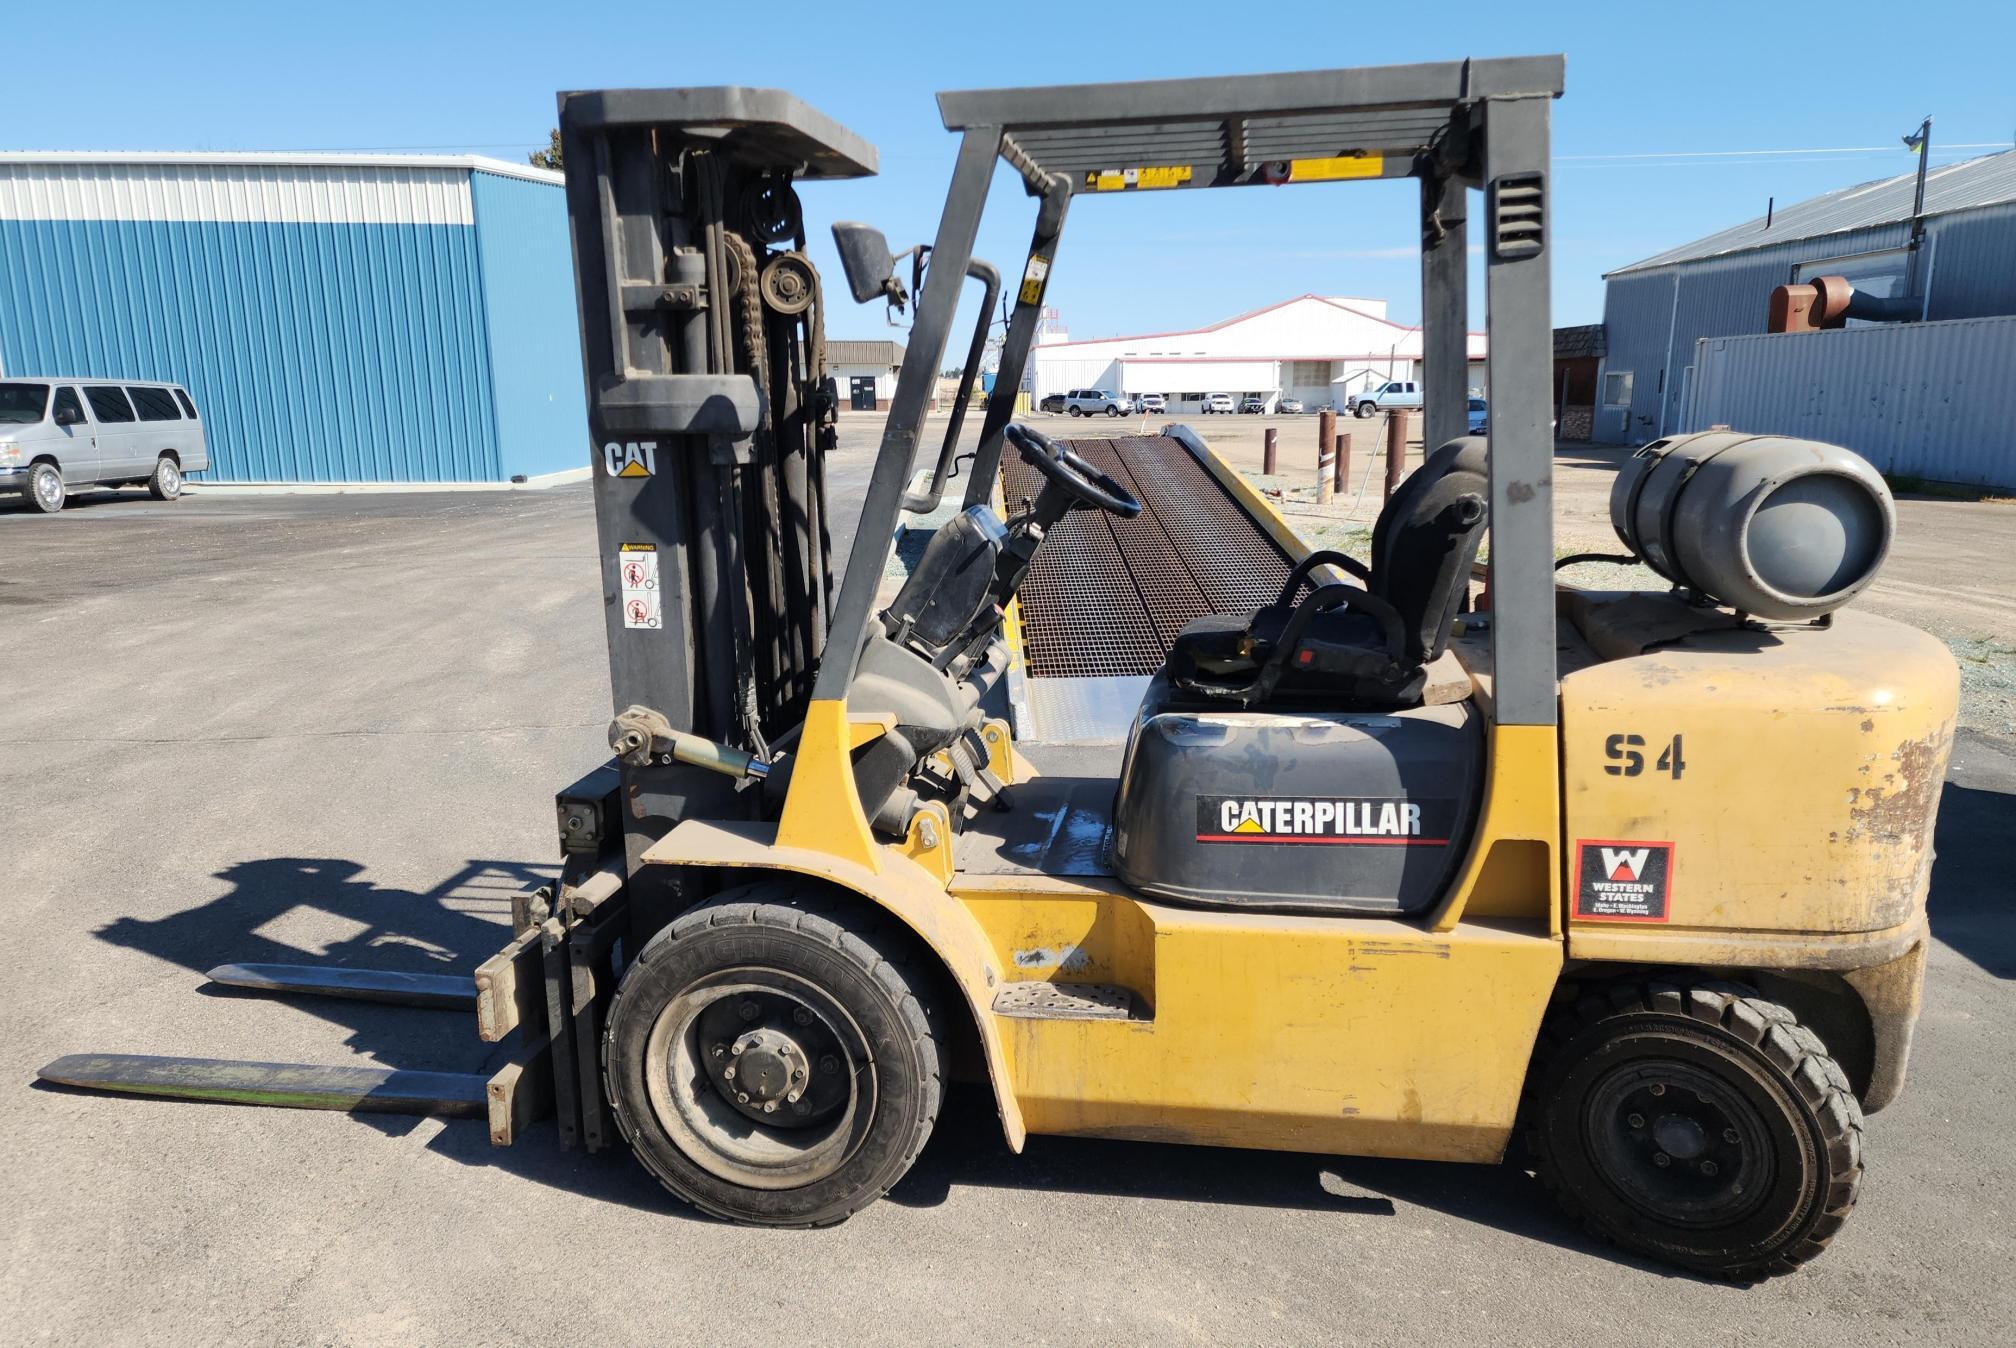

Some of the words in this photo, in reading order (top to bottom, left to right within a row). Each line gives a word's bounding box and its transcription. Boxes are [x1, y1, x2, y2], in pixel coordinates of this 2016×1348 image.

[604, 441, 657, 477] CAT
[1220, 800, 1421, 835] CATERPILLAR
[1600, 847, 1650, 881] W
[1593, 882, 1654, 893] WESTERN
[1600, 892, 1644, 902] STATES
